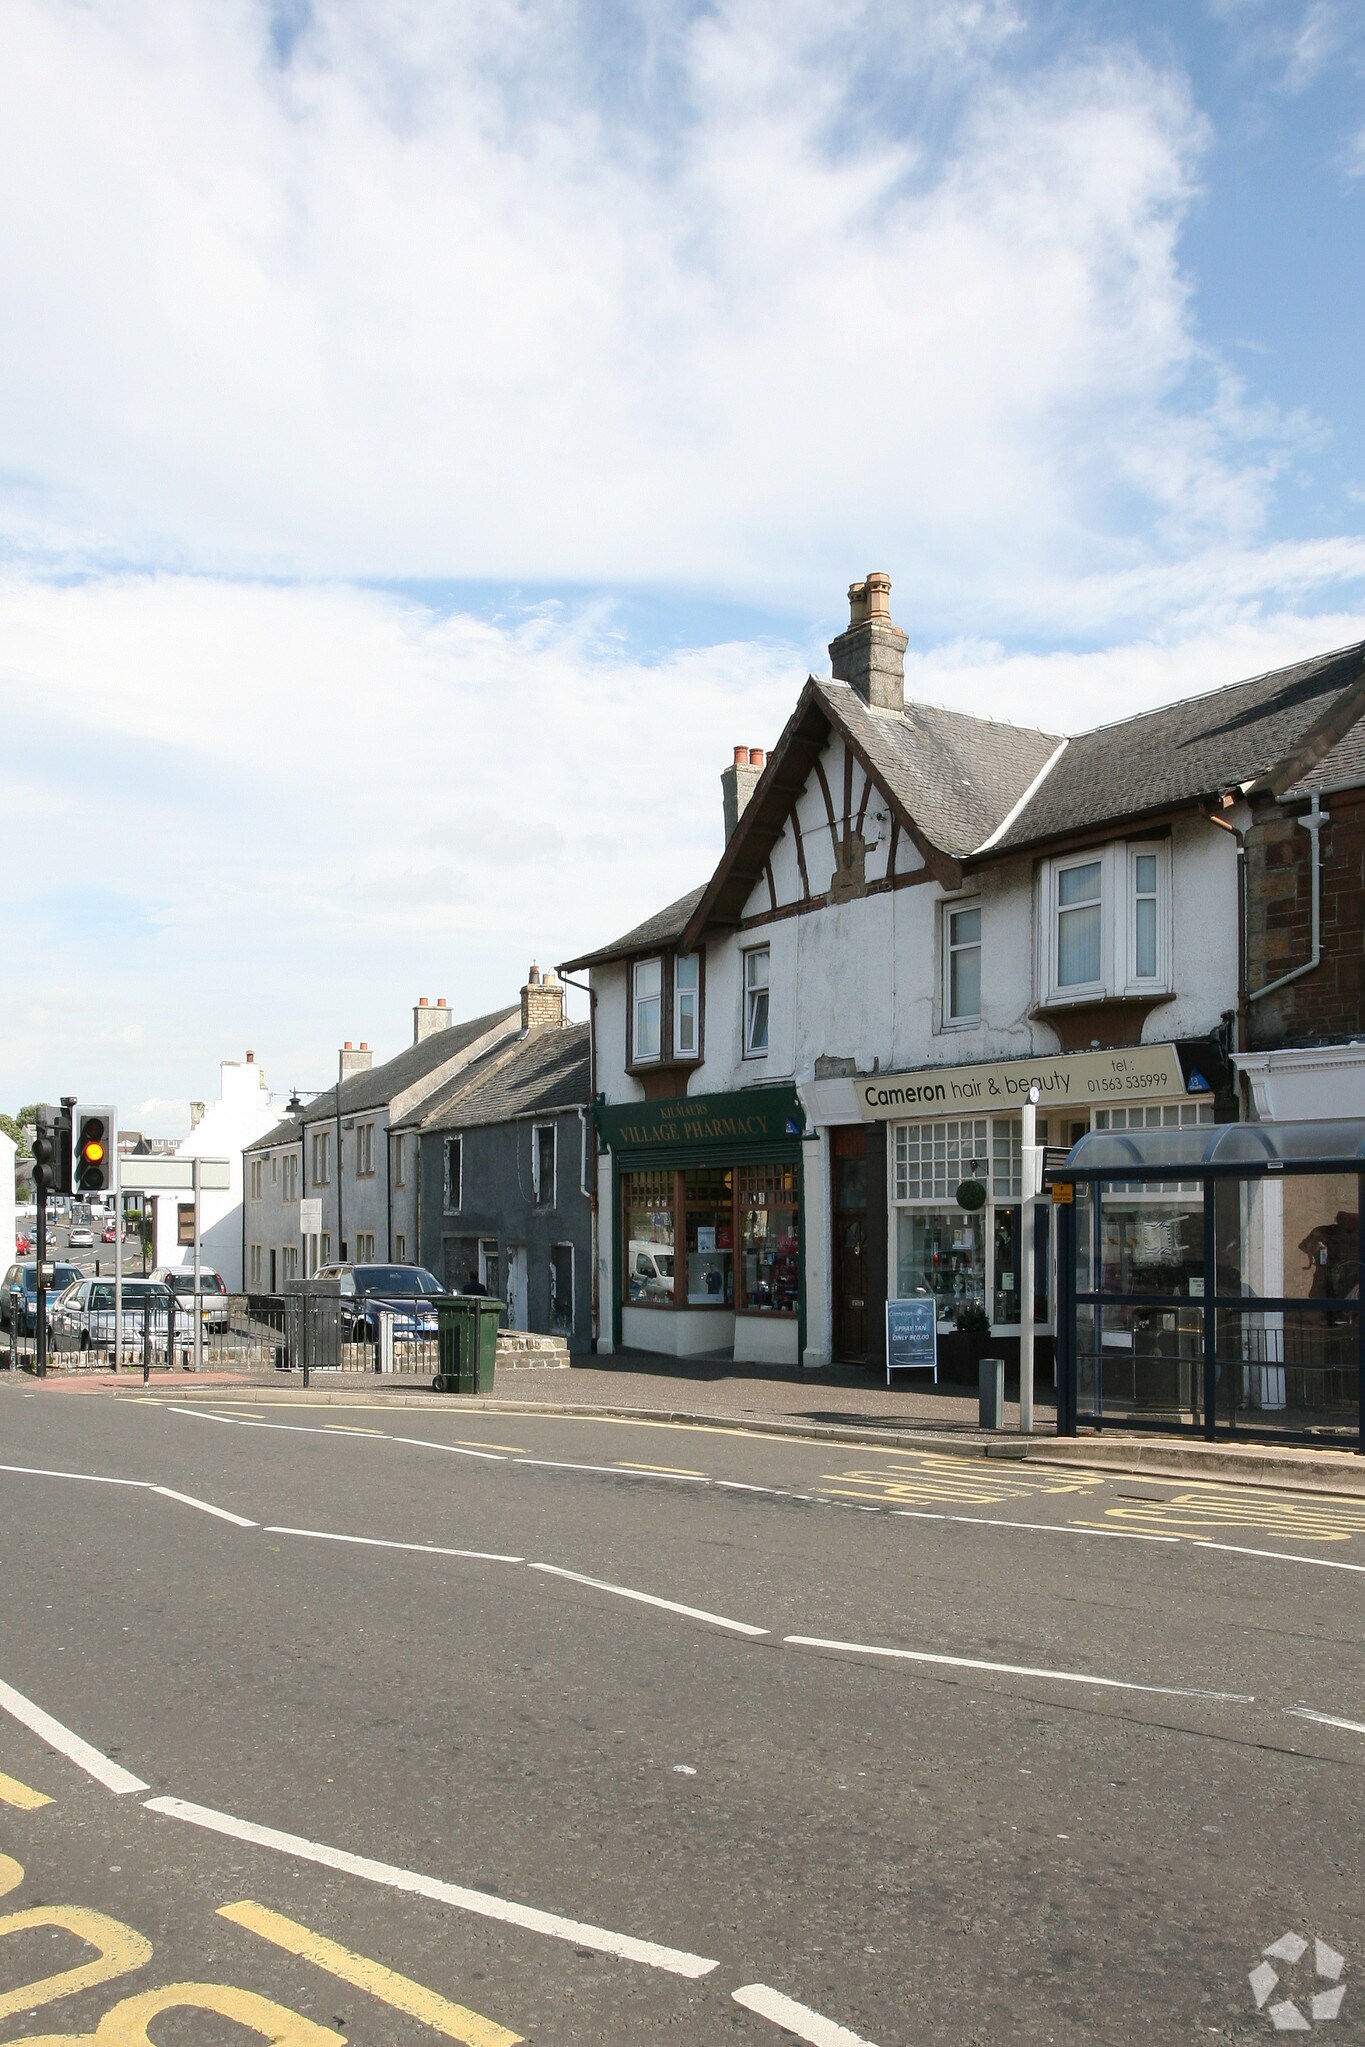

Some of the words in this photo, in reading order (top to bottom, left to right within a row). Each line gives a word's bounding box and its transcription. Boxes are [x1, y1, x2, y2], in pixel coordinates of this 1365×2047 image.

[865, 1084, 946, 1106] Cameron
[951, 1078, 982, 1099] hair
[988, 1077, 1002, 1096] &
[1004, 1071, 1070, 1094] beauty
[1087, 1077, 1123, 1093] 01563
[1126, 1073, 1168, 1089] 535999
[659, 1103, 709, 1119] KILMAURS
[619, 1124, 680, 1143] VILLAGE
[684, 1115, 768, 1139] PHARMACY
